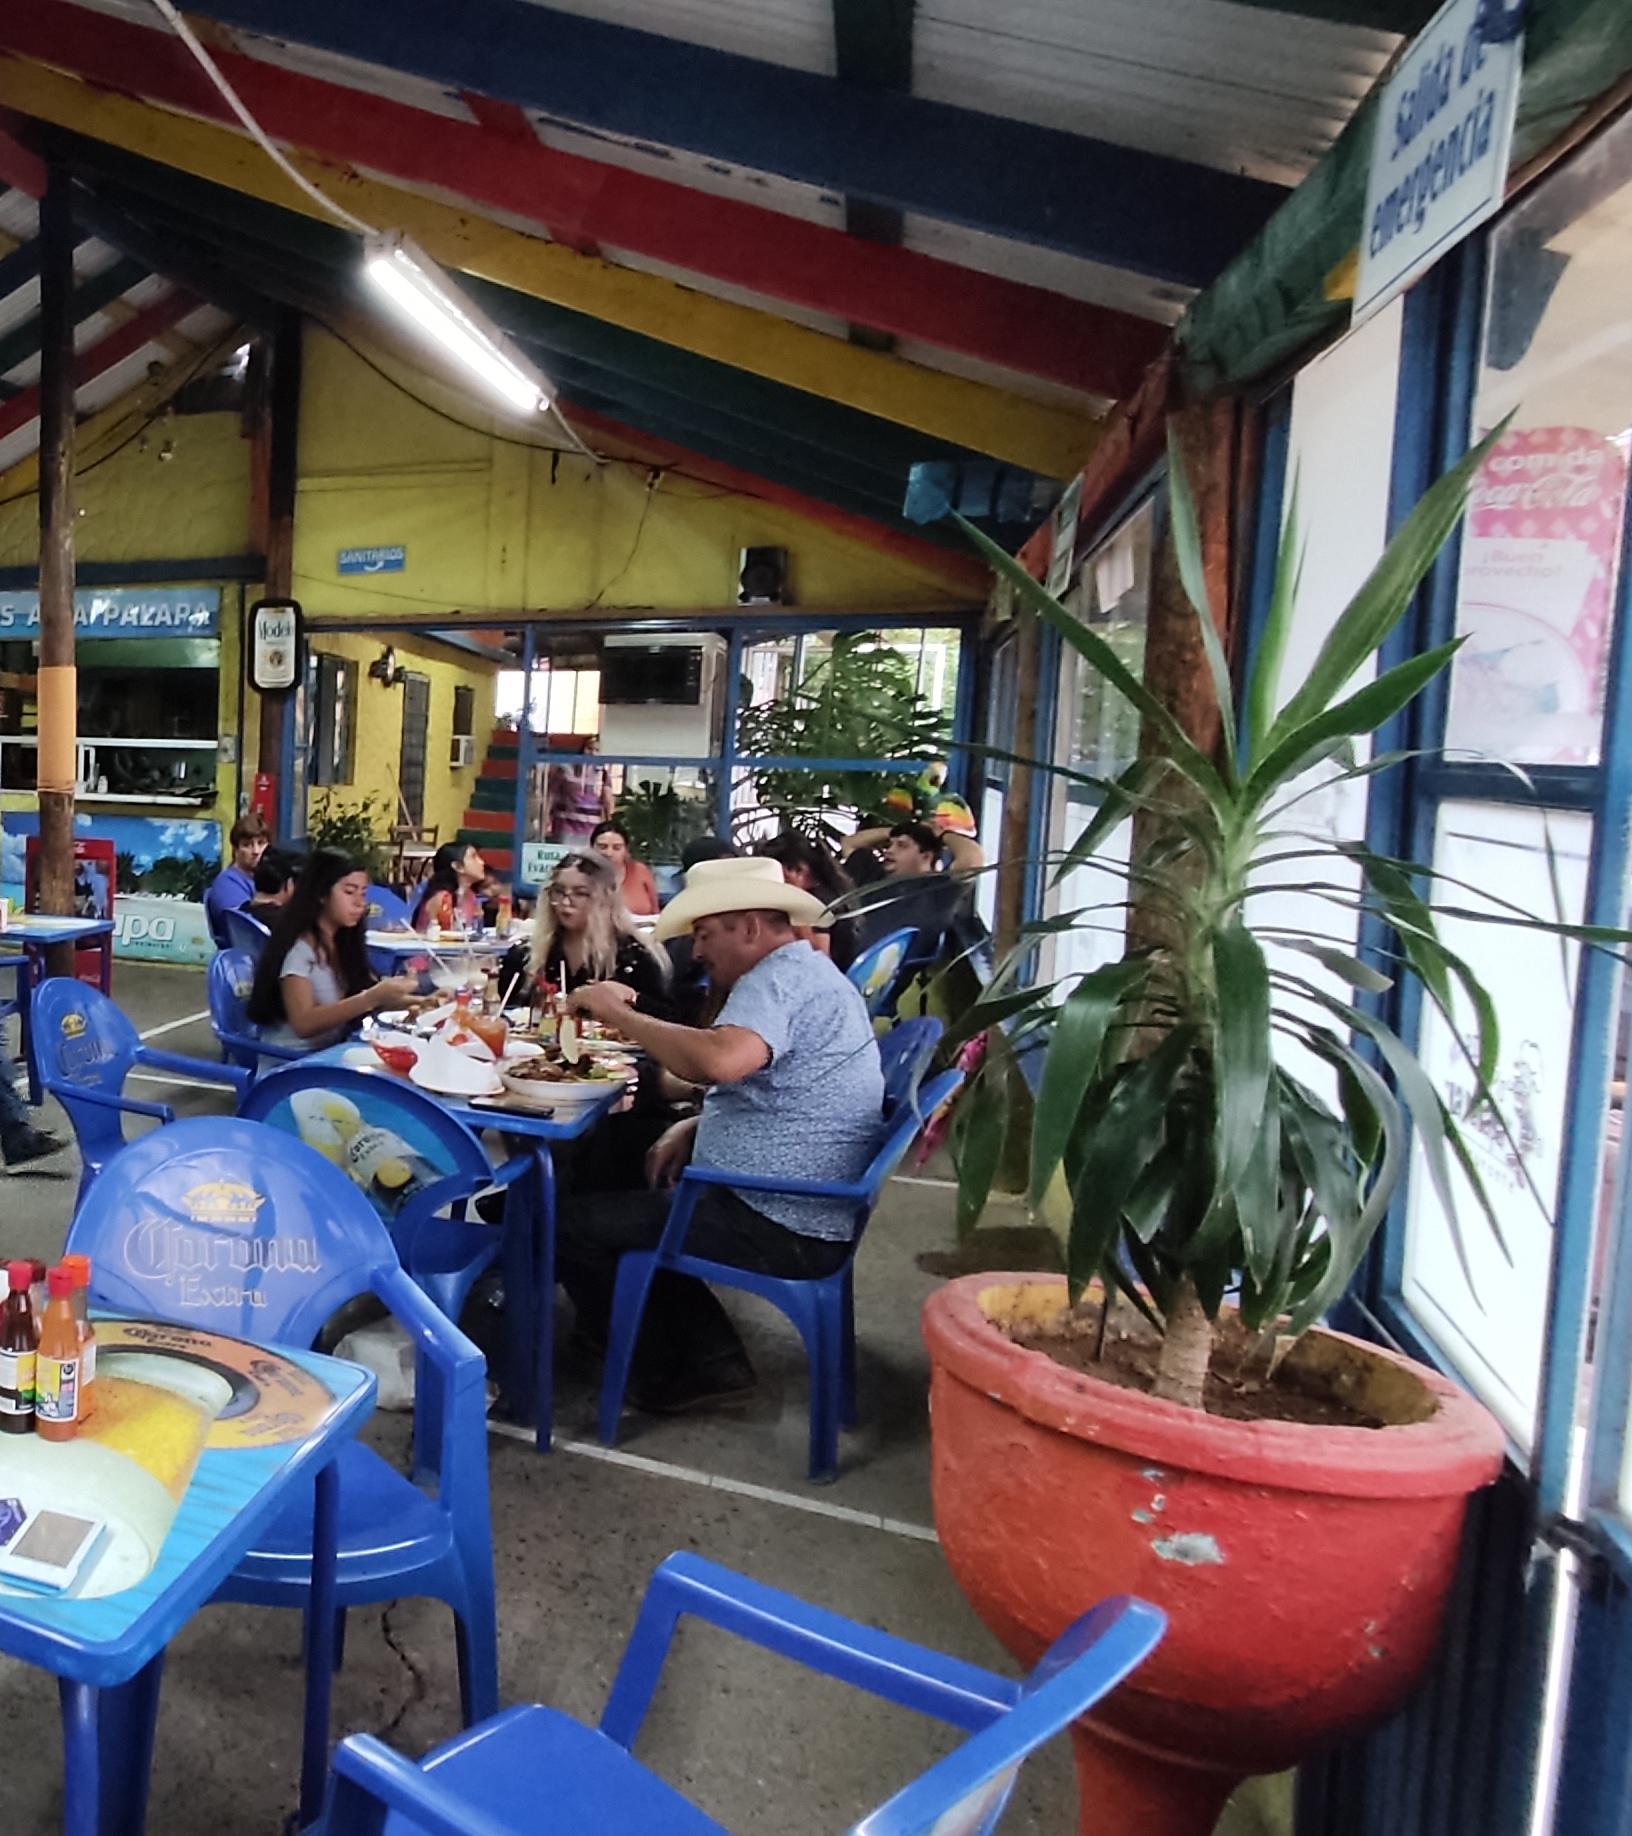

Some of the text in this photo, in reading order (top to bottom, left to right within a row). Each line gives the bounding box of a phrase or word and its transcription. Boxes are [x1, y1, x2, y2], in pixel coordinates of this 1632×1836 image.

[339, 546, 404, 564] SANITARIOS
[124, 1217, 322, 1286] Corona
[180, 1274, 268, 1308] Extra
